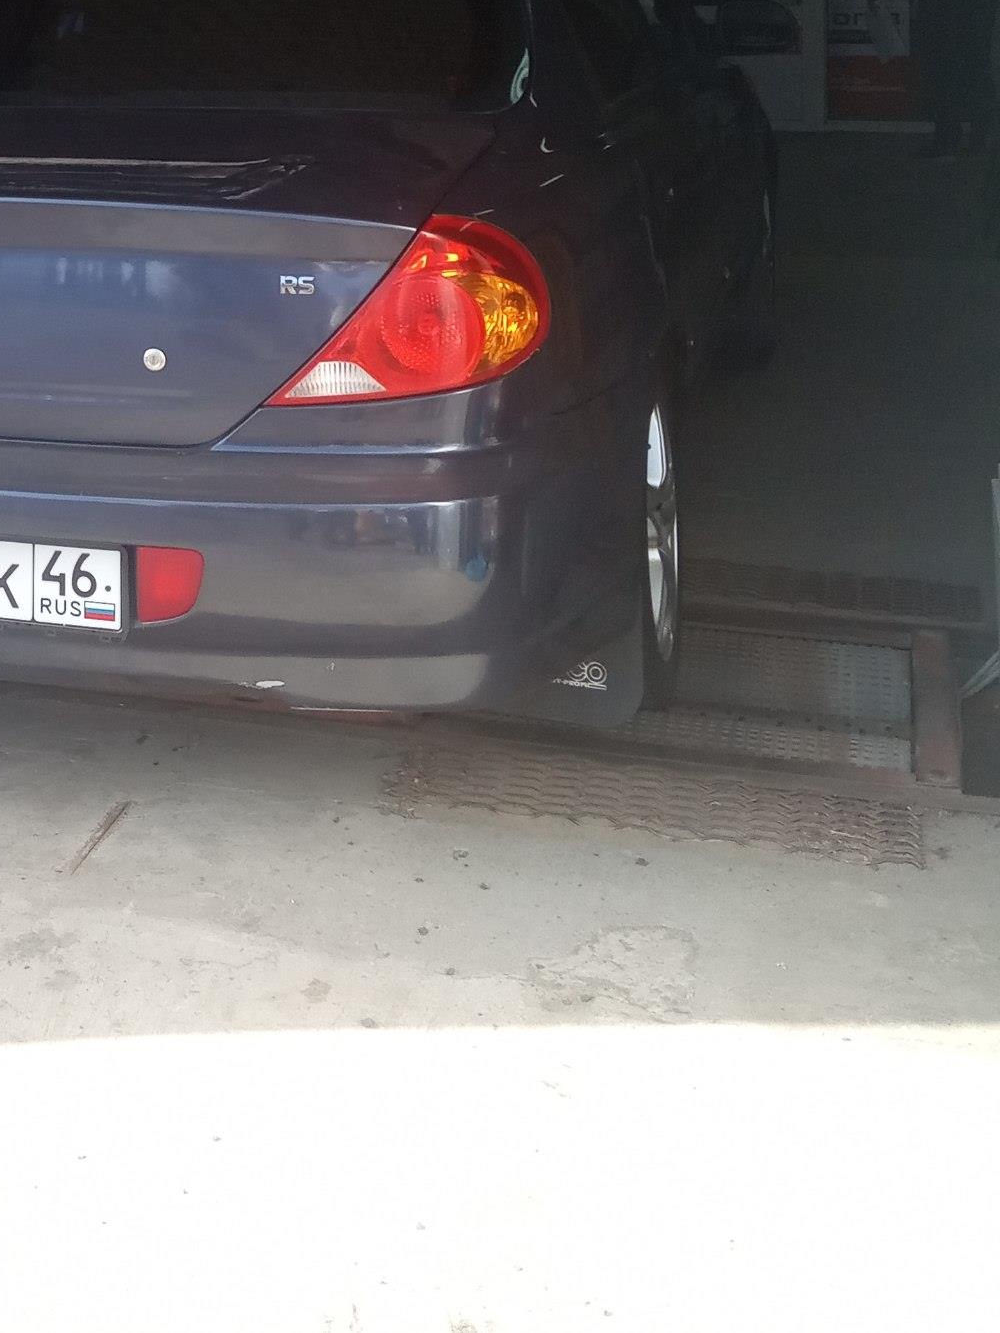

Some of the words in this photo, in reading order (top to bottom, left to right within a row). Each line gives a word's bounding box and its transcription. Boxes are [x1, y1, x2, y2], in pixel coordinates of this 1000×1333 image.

[280, 275, 315, 295] RS
[41, 550, 98, 599] 46
[40, 597, 82, 617] RUS
